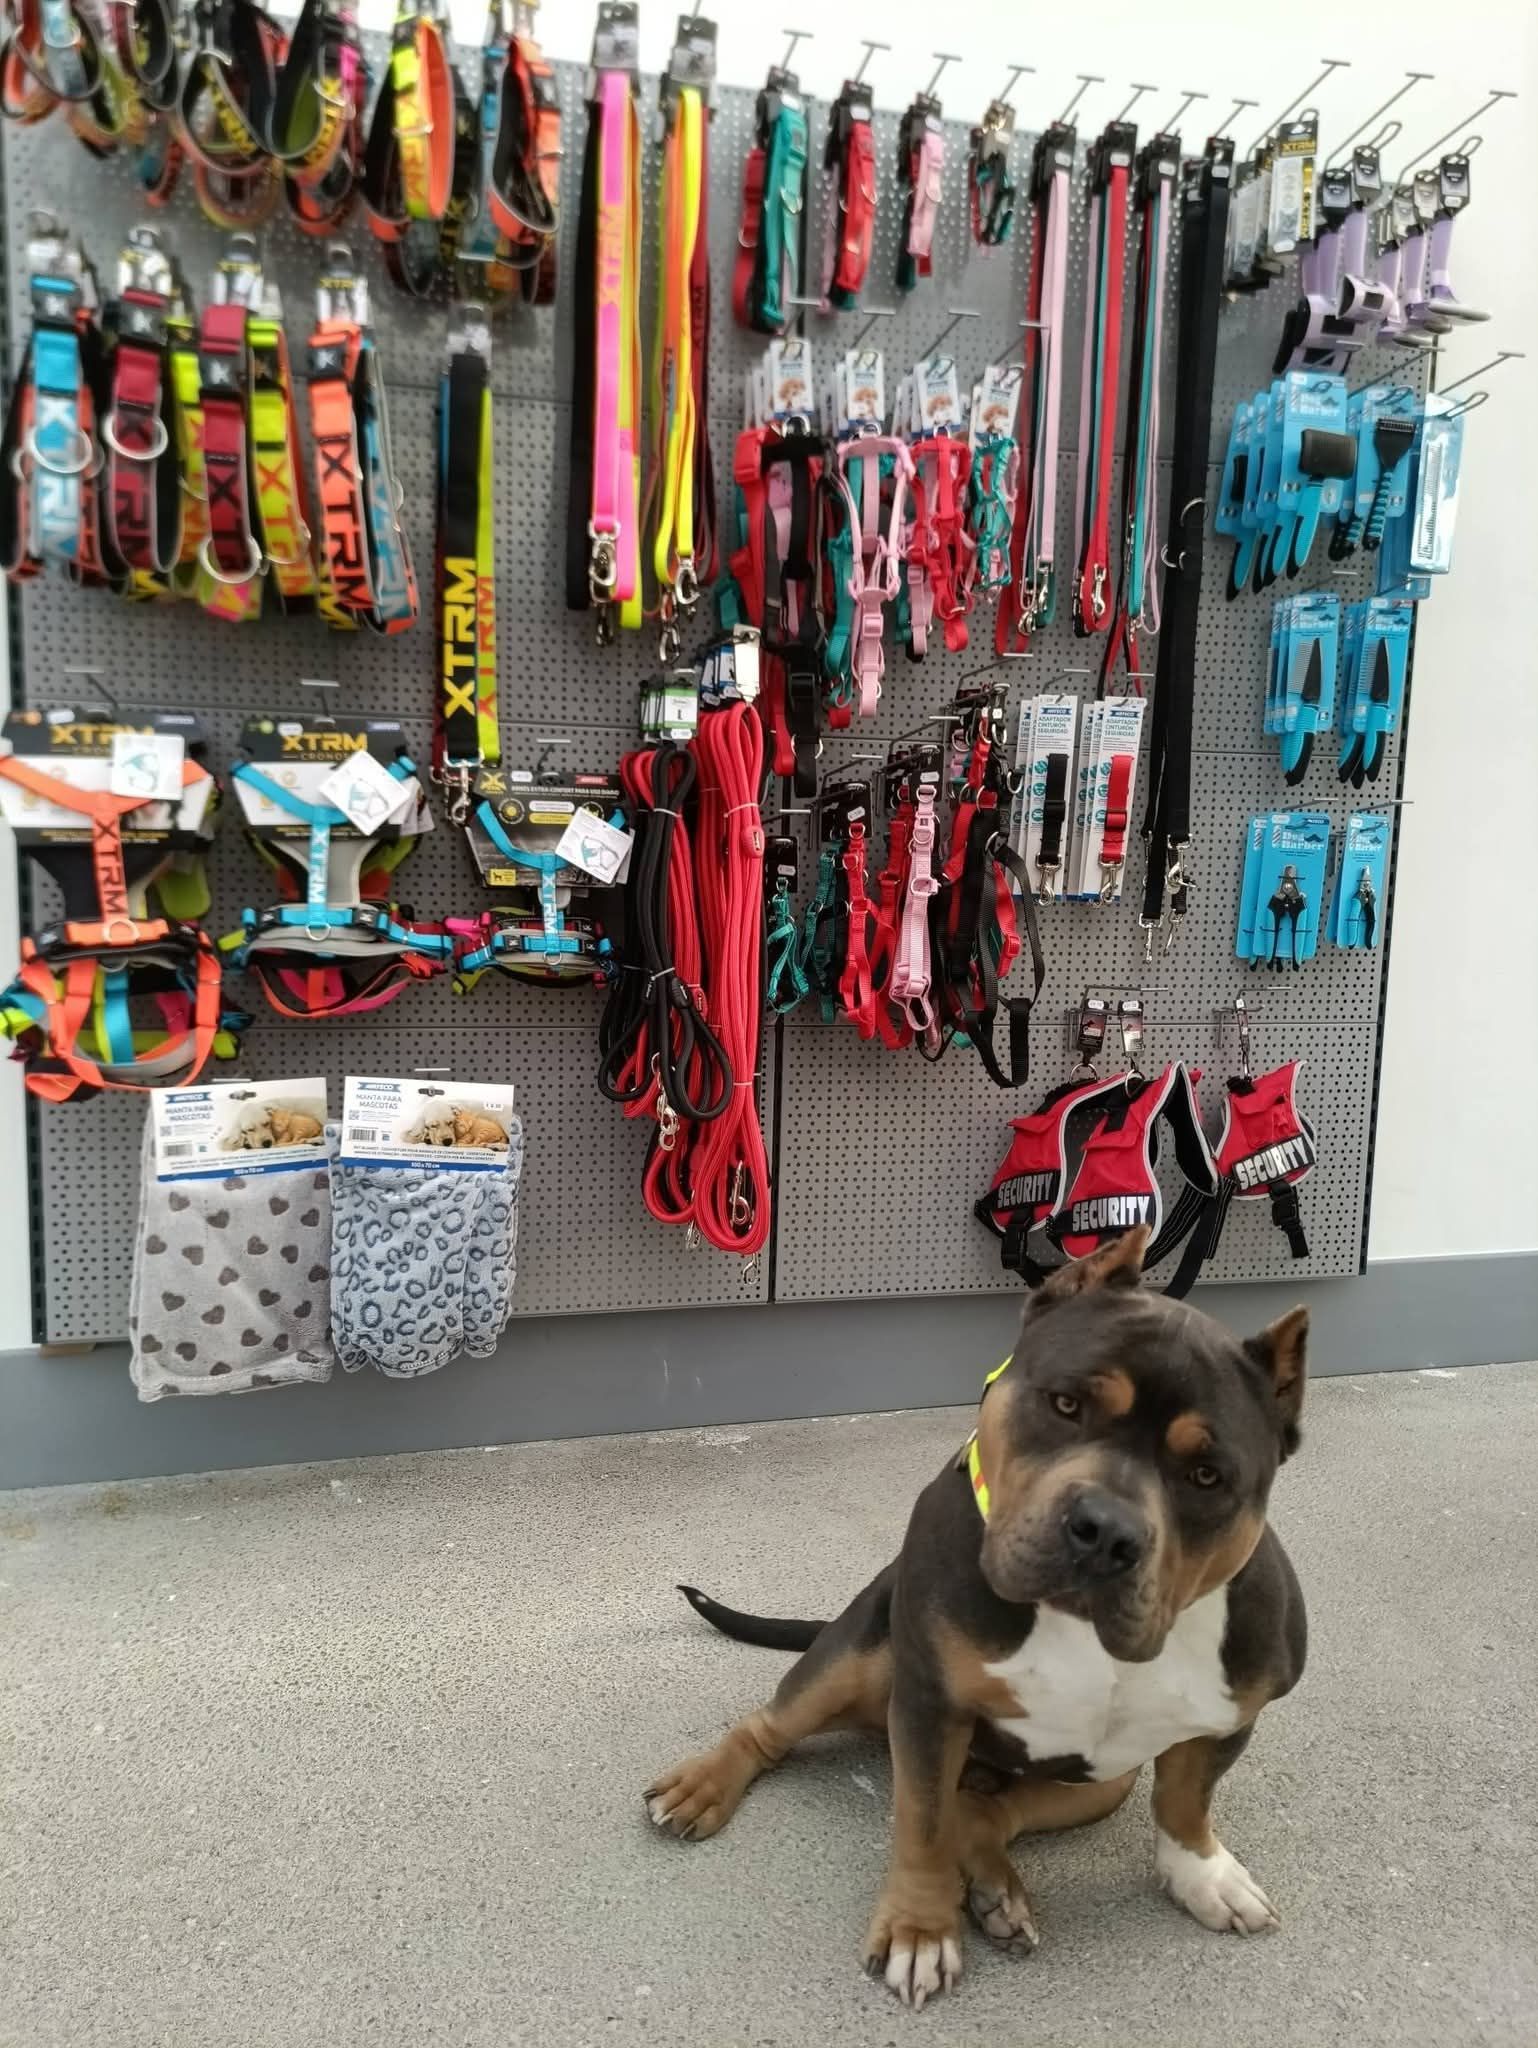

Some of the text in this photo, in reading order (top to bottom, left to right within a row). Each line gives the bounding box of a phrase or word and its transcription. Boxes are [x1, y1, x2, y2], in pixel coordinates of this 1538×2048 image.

[319, 447, 376, 611] XTRM
[444, 557, 476, 719] XTRM
[282, 733, 368, 751] XTRM
[94, 818, 127, 913] XTRM
[359, 1101, 398, 1110] MASCOTAS
[1236, 1135, 1309, 1190] SECURITY
[998, 1173, 1054, 1205] SECURITY
[1072, 1196, 1151, 1232] SECURITY
